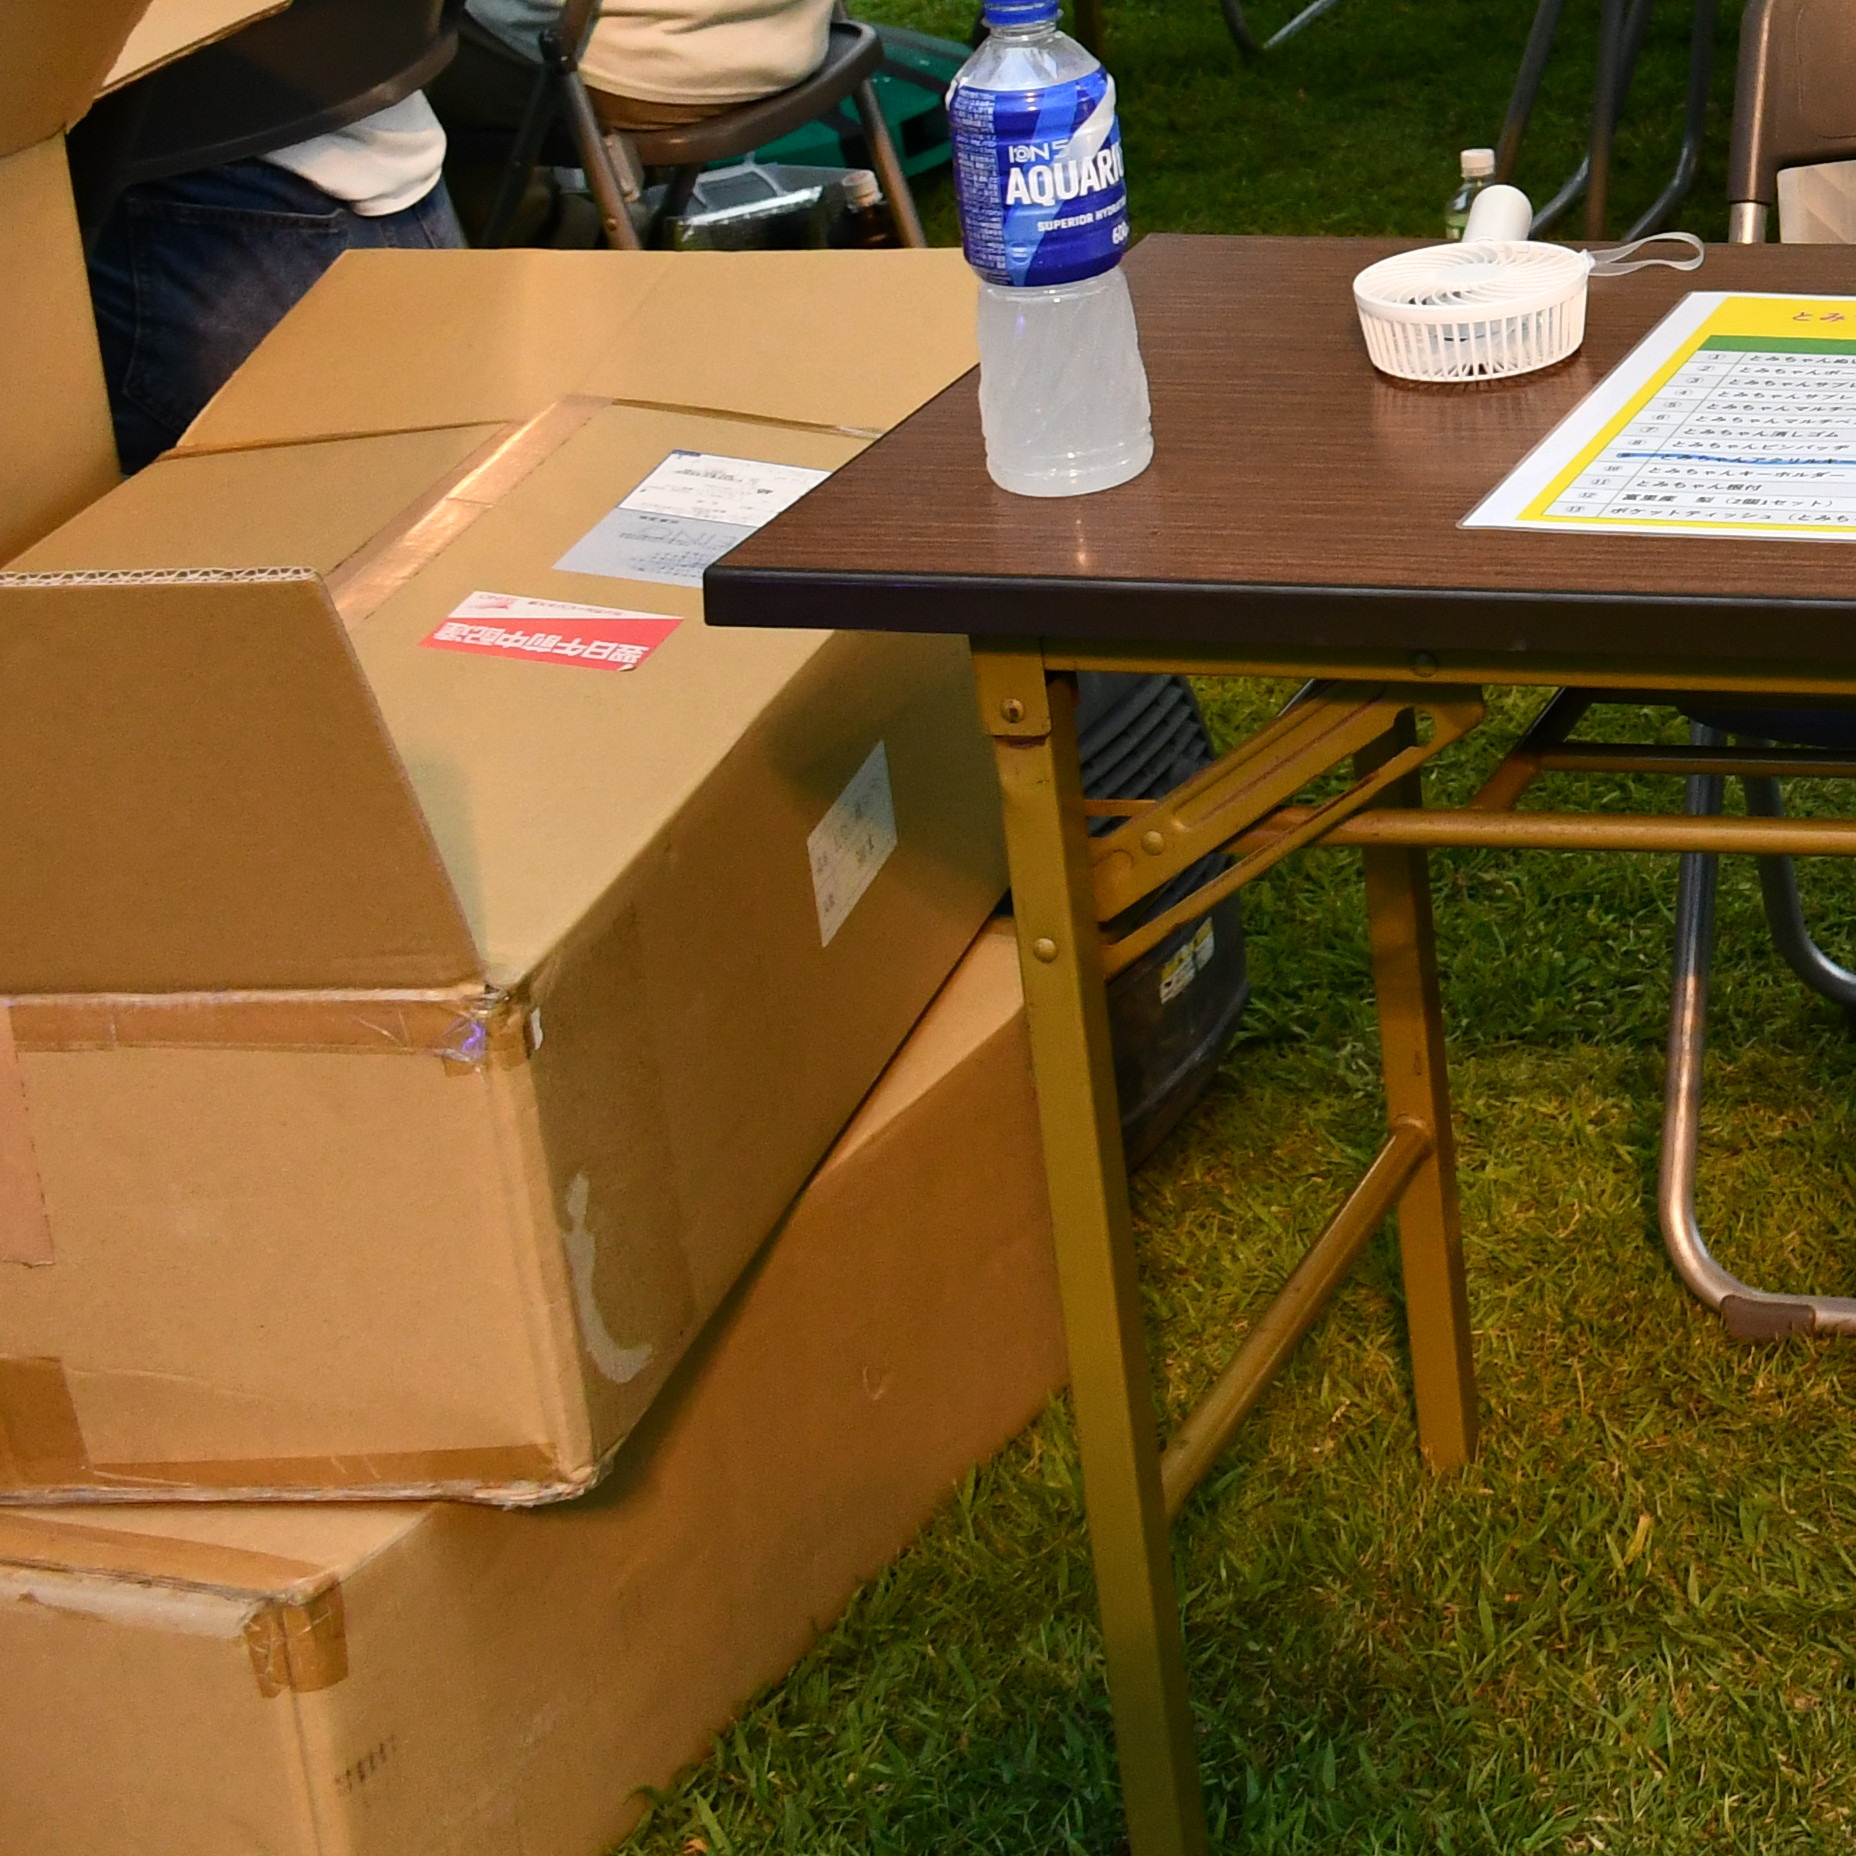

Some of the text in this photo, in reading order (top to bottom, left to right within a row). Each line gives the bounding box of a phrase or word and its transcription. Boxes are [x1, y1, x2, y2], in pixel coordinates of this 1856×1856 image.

[1037, 211, 1095, 232] SUPERIOR
[434, 621, 650, 665] 翌日午前中配達
